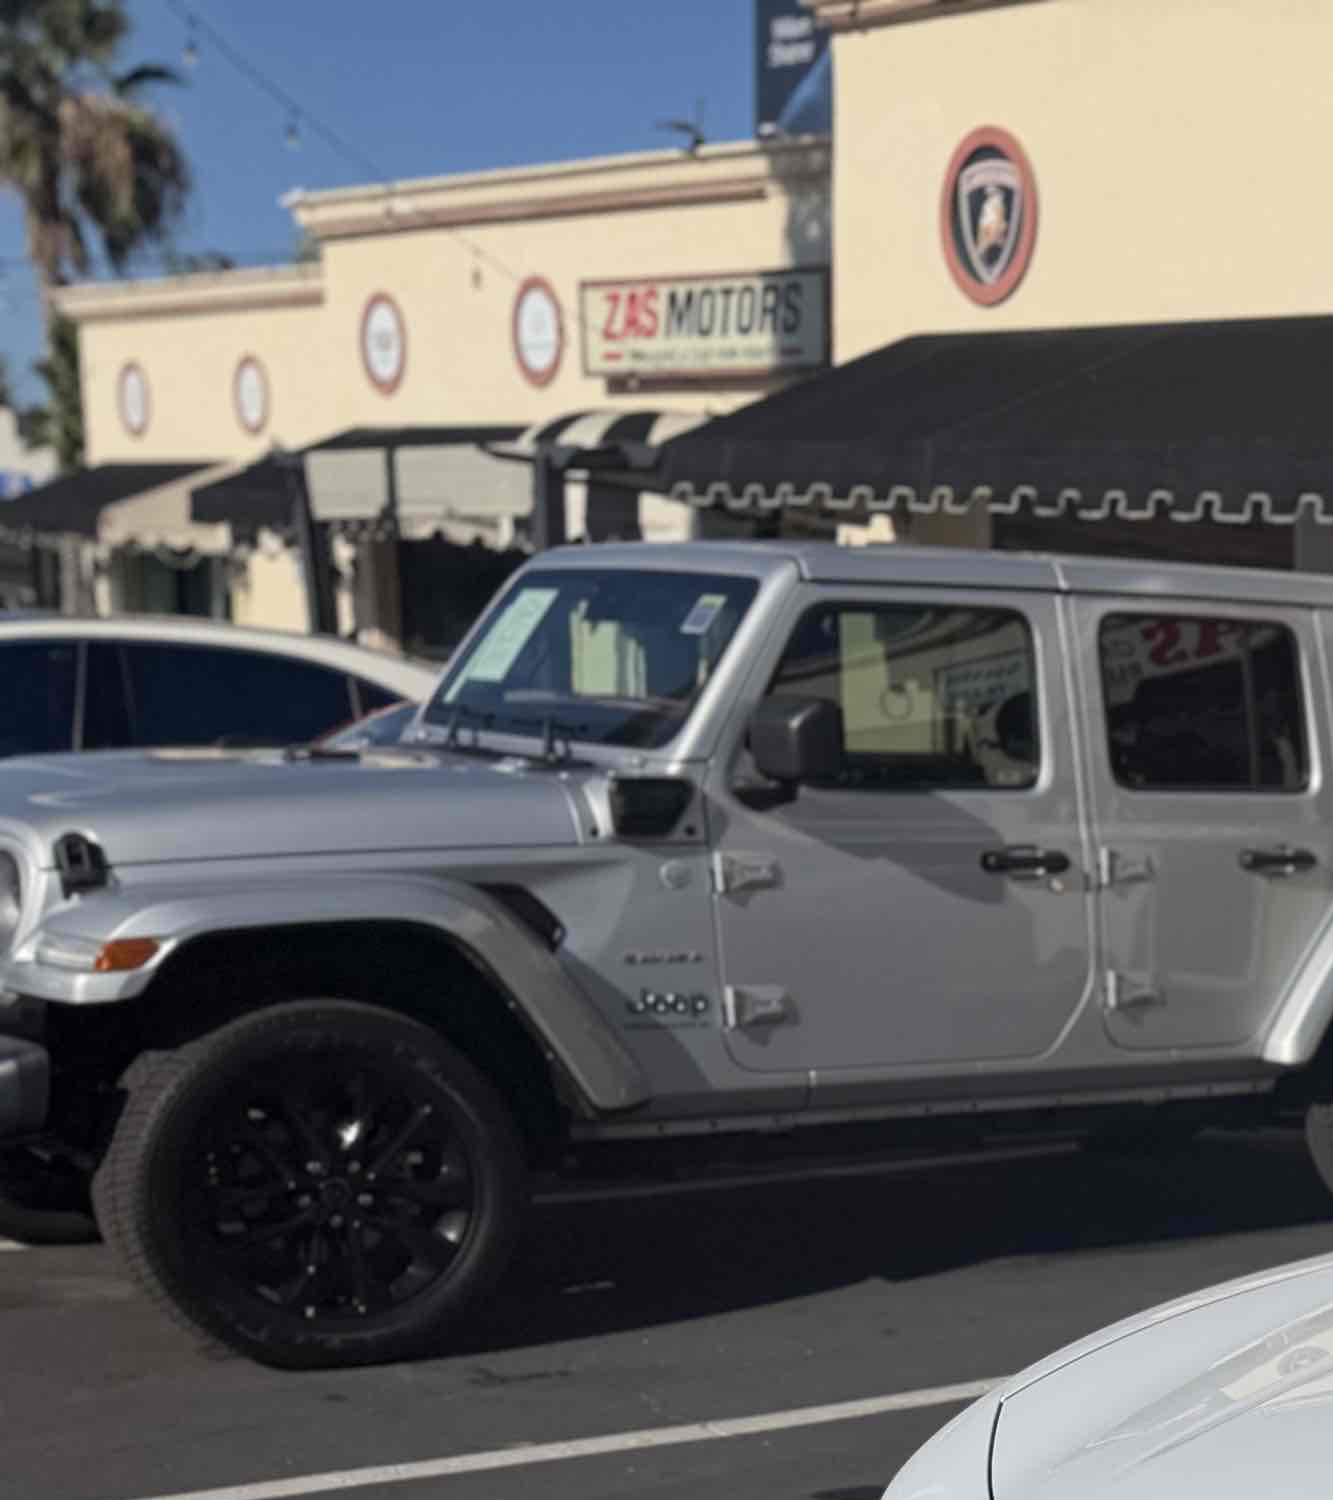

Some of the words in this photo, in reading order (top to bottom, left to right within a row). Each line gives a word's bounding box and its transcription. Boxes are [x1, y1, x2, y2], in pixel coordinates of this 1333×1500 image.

[602, 285, 658, 341] ZAS
[664, 280, 804, 339] MOTORS
[624, 986, 710, 1019] Jeep
